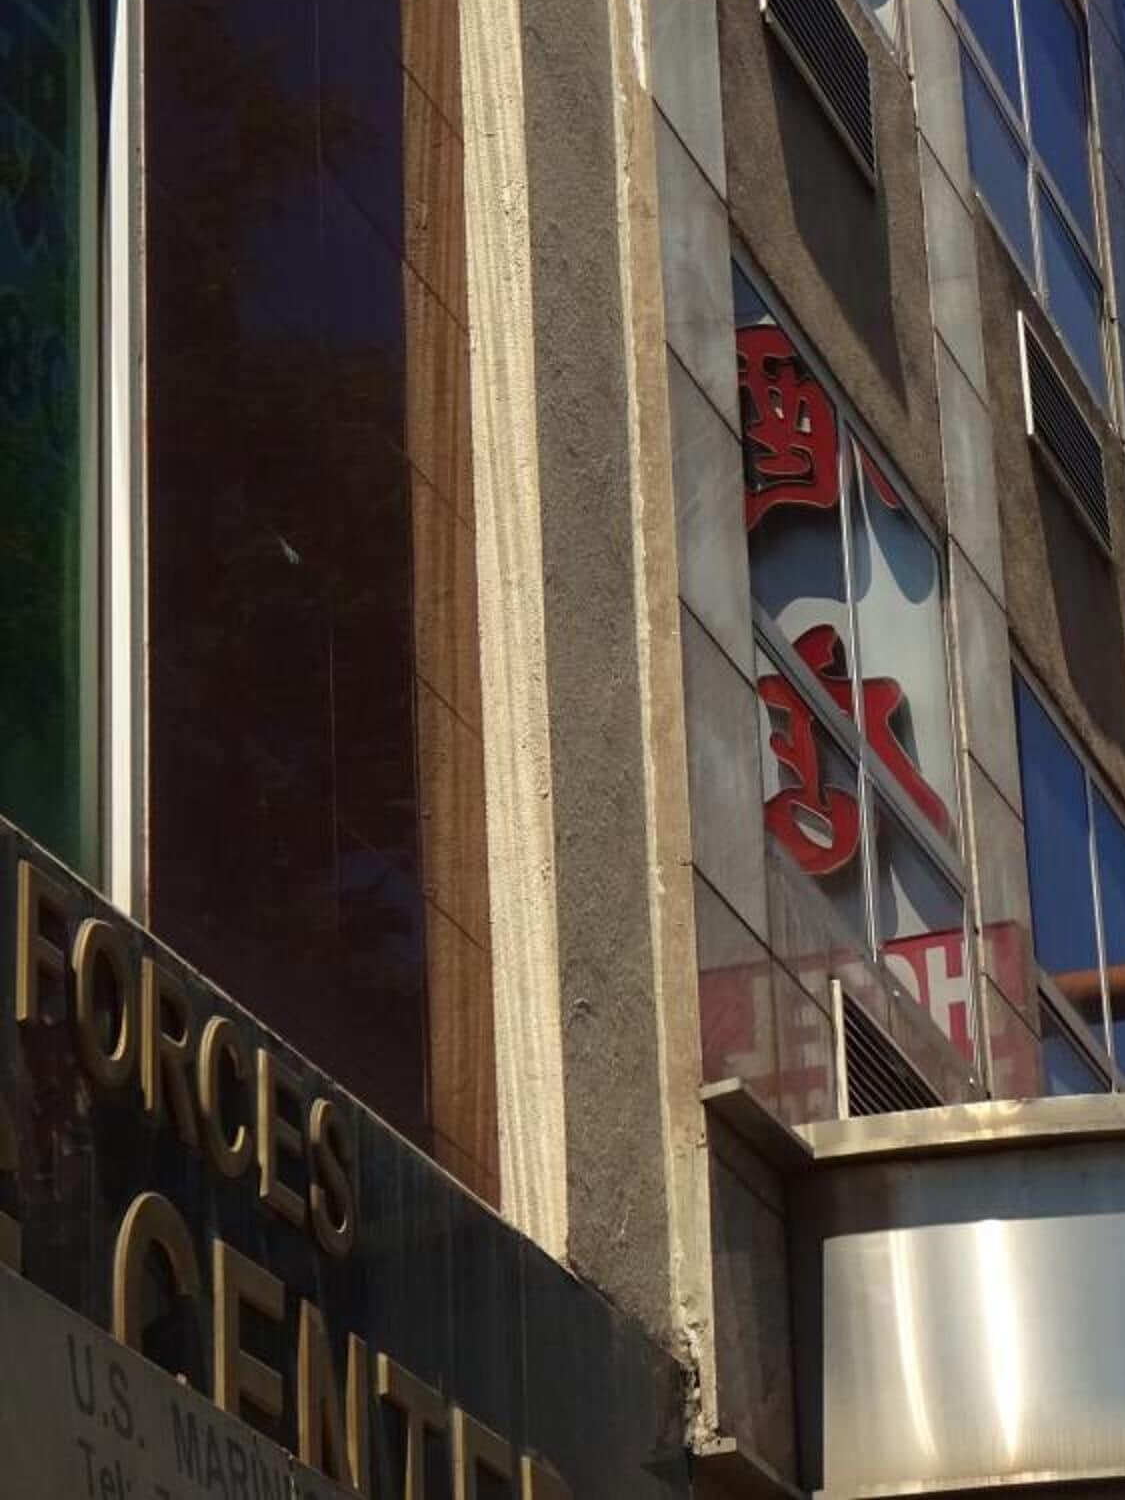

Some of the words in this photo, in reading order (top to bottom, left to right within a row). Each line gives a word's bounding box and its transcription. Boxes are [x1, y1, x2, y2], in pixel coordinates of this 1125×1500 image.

[14, 856, 360, 1260] FORCES
[66, 1331, 146, 1451] U.S.
[171, 1395, 318, 1500] MARIN
[112, 1190, 576, 1500] CENT
